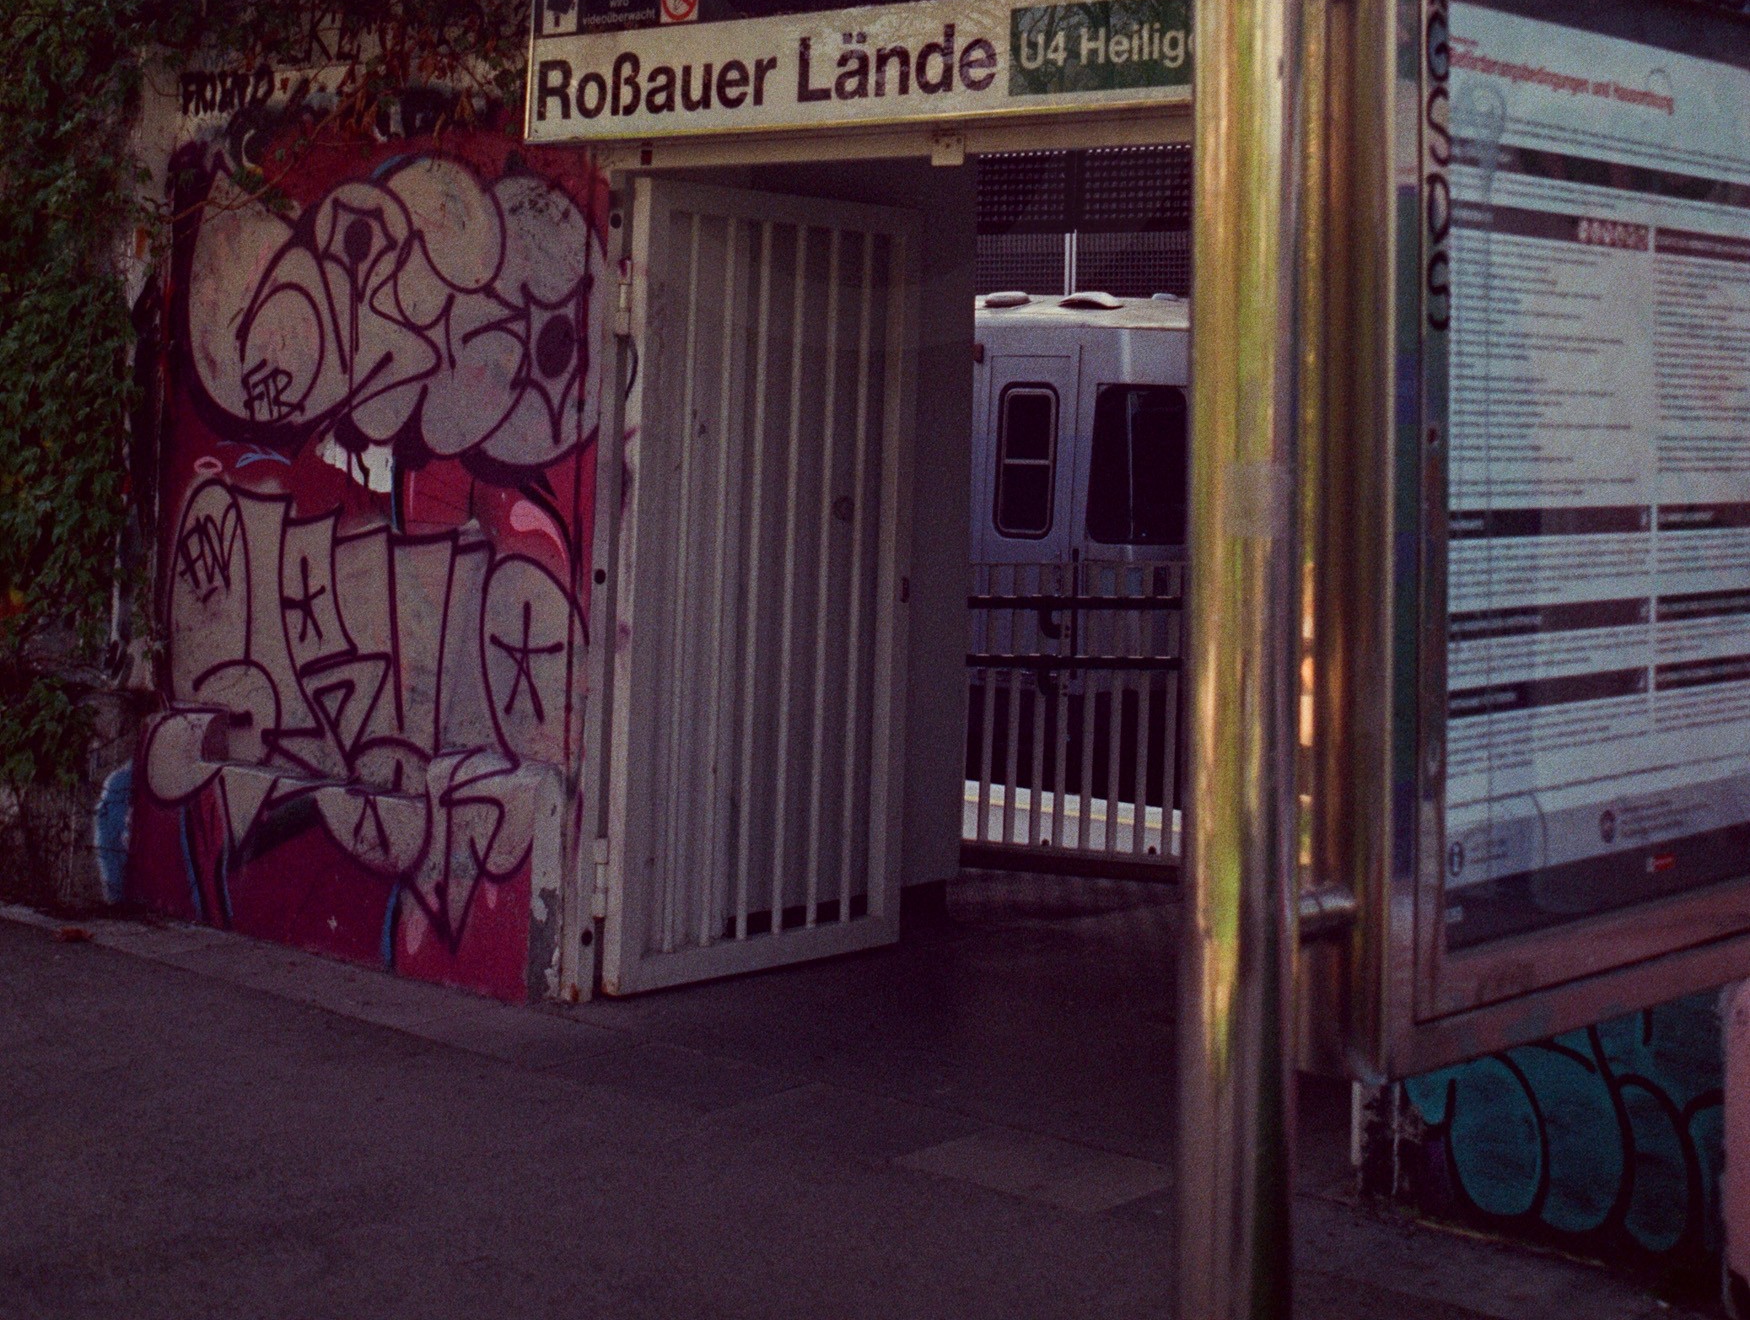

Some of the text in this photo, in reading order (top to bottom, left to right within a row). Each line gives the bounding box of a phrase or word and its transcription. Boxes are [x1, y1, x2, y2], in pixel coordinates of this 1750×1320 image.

[582, 8, 655, 25] videoüberwacht
[1019, 21, 1194, 70] U4 Heilig
[536, 23, 998, 122] Roßauer Lände
